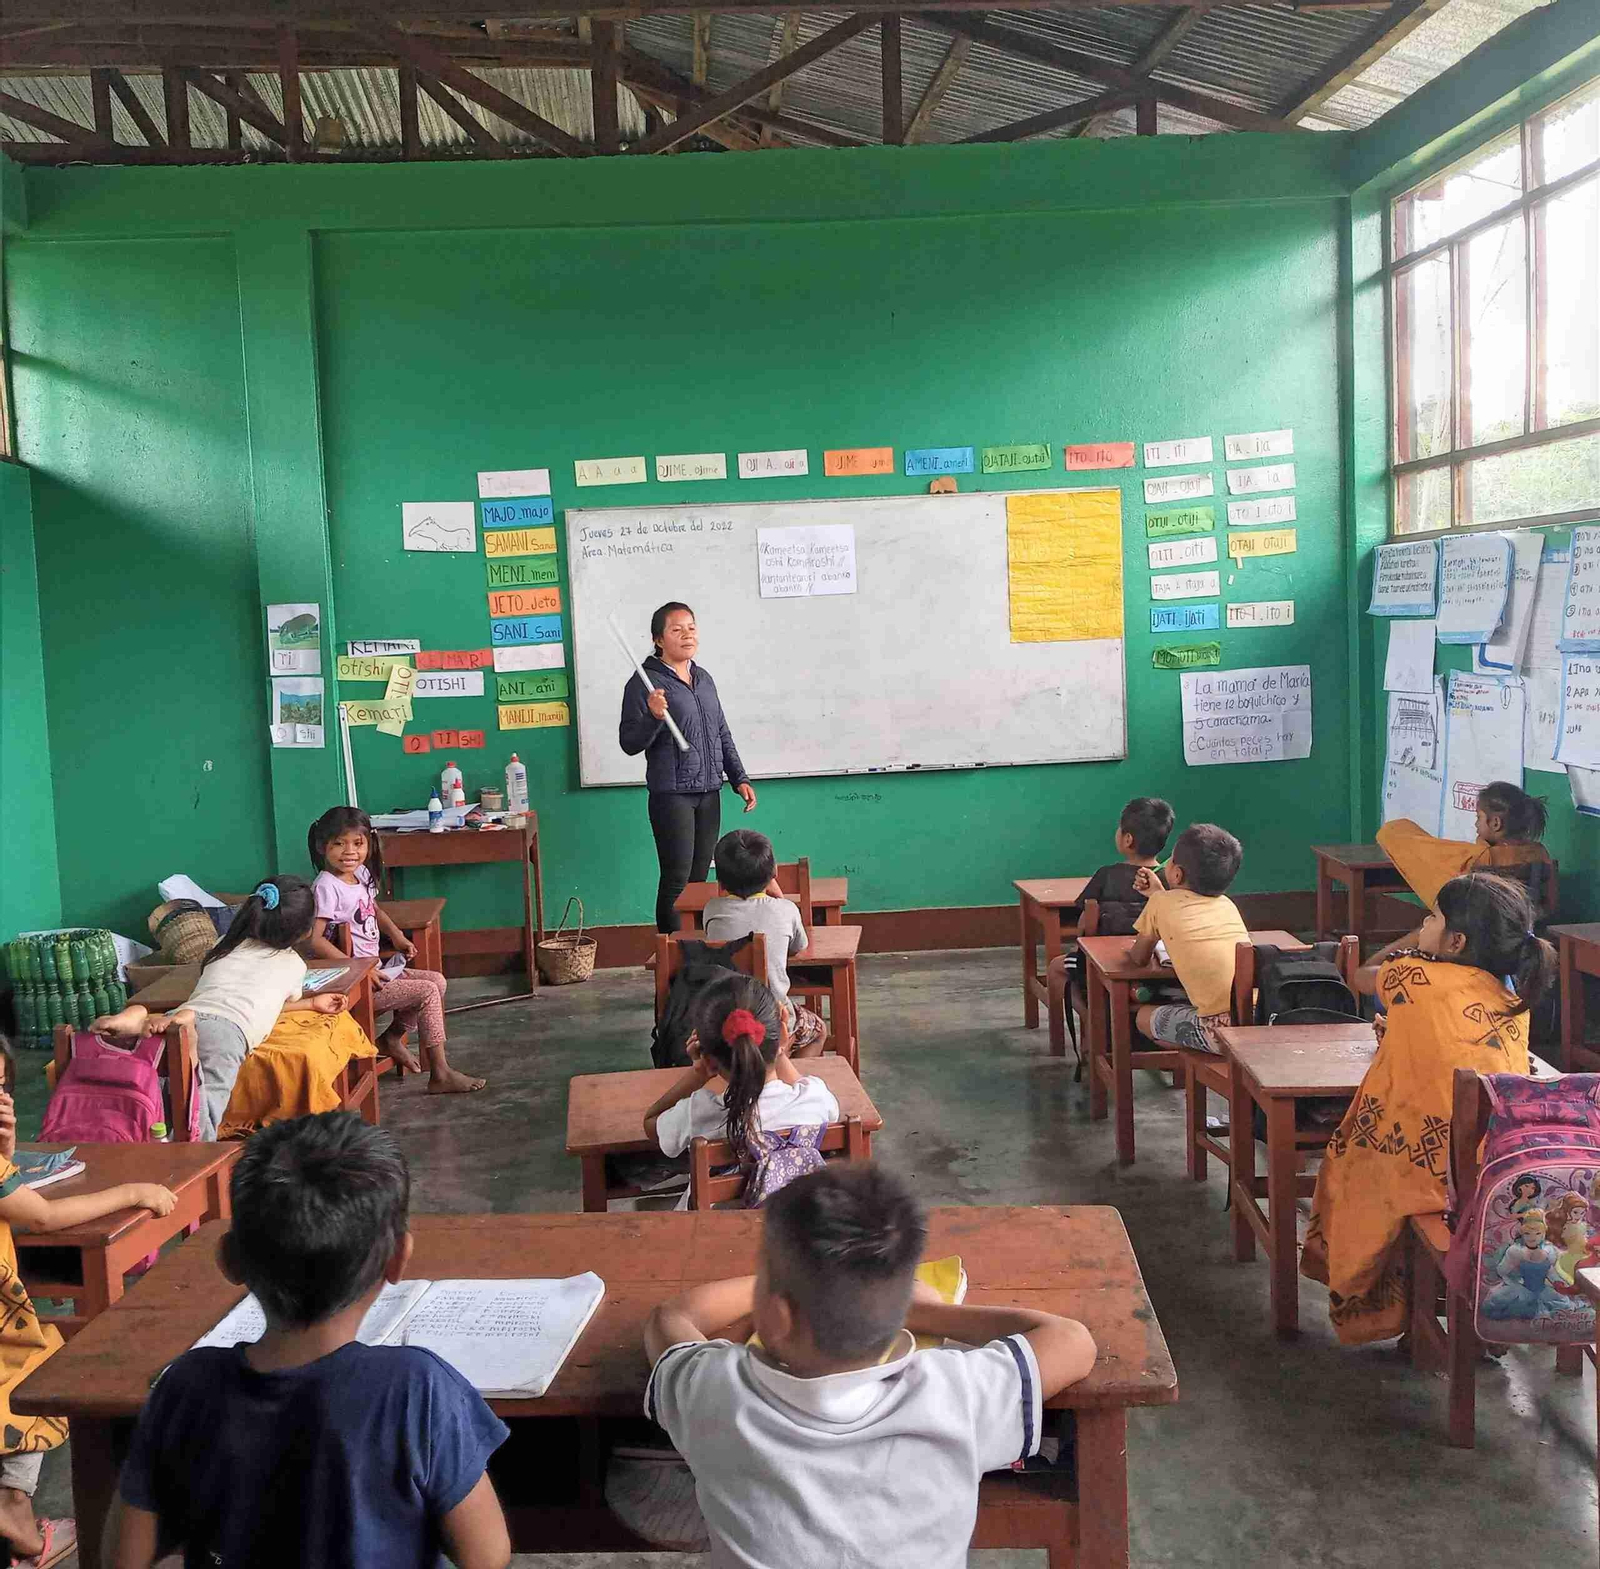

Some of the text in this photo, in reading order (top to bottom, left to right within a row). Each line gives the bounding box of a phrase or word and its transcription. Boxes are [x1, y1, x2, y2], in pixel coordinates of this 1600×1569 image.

[620, 527, 632, 536] 27
[636, 521, 648, 534] de
[690, 518, 703, 531] del
[710, 520, 733, 531] 2022
[416, 677, 466, 690] OTISHI
[1195, 679, 1212, 694] La
[1262, 675, 1276, 690] de
[1193, 698, 1224, 712] tiene
[1225, 698, 1235, 709] 12
[1292, 693, 1300, 706] y
[1240, 735, 1271, 746] peces
[1211, 750, 1226, 760] en
